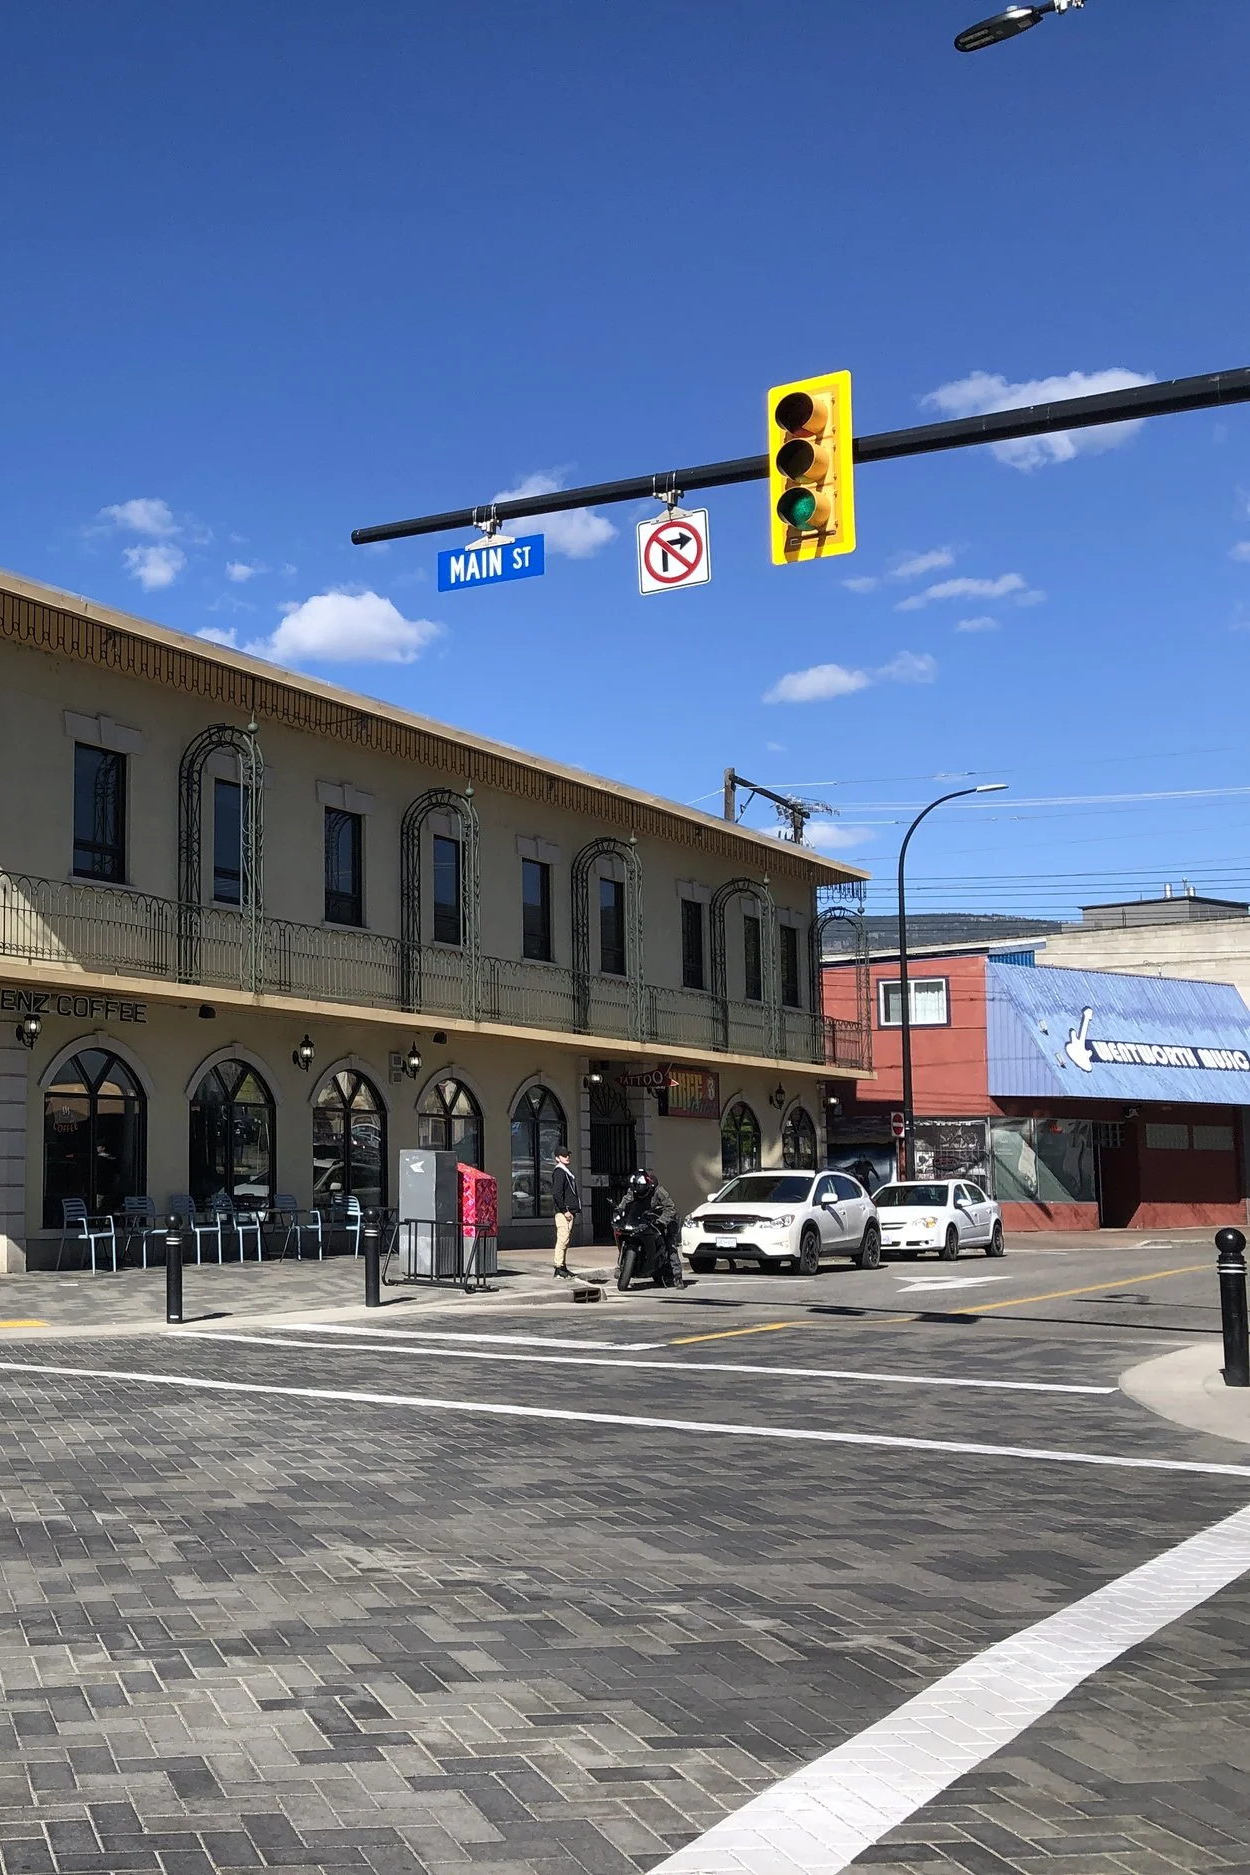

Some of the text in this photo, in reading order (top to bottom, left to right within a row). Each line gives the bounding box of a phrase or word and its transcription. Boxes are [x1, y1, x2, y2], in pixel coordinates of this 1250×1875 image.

[450, 546, 531, 584] MAIN ST
[56, 994, 148, 1024] COFFEE
[1091, 1041, 1250, 1071] WENTWORTH MUSIC
[619, 1070, 663, 1086] TATTOO
